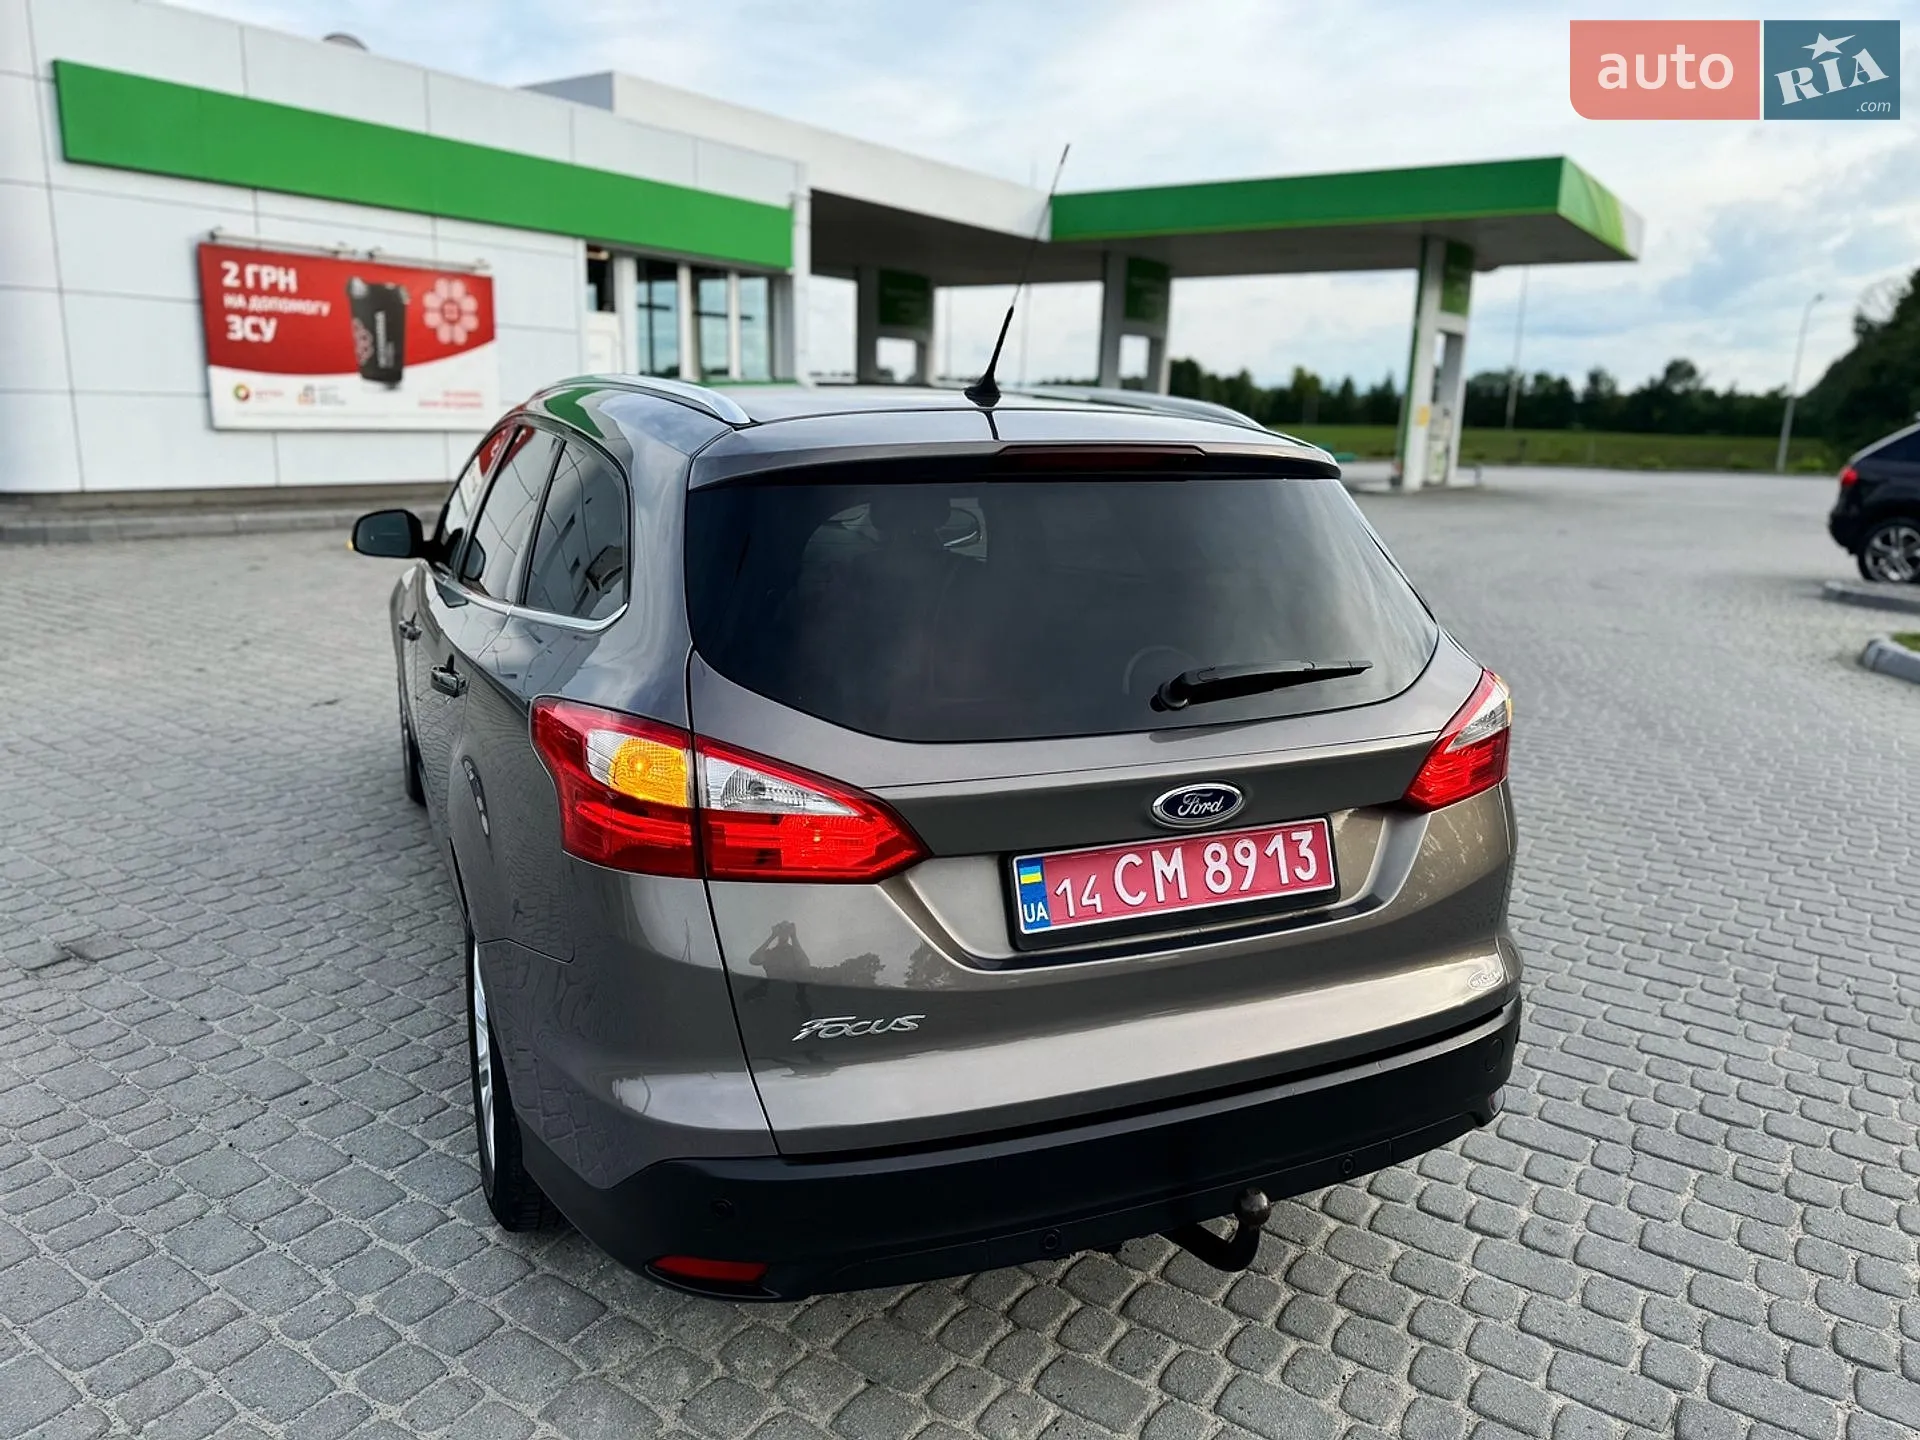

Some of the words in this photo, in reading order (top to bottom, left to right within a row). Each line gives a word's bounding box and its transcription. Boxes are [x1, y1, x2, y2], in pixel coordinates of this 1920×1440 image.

[220, 260, 241, 288] 2
[244, 264, 299, 293] ГРН
[225, 314, 278, 343] ЗСУ
[1177, 791, 1224, 817] Ford
[1055, 874, 1103, 918] 14
[1113, 847, 1188, 906] CM
[1203, 829, 1318, 894] 8913
[1023, 902, 1049, 924] UA
